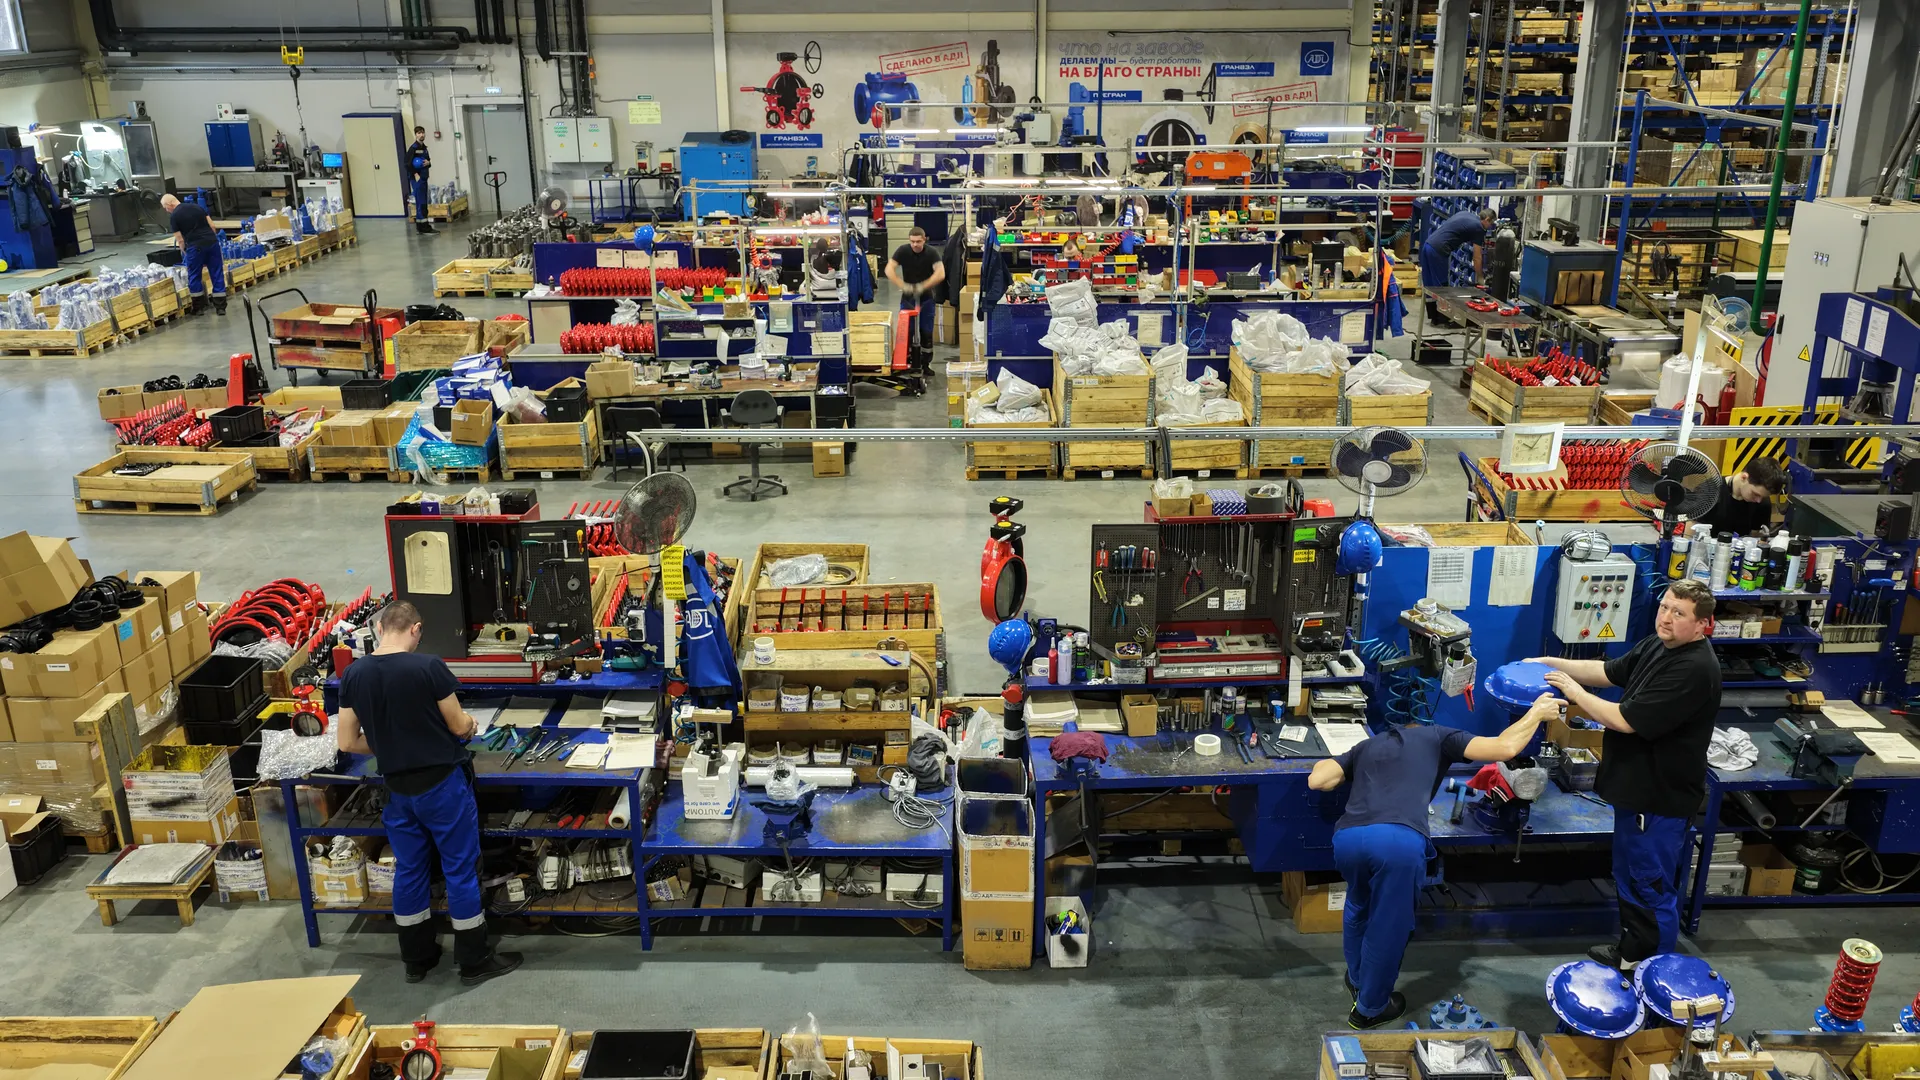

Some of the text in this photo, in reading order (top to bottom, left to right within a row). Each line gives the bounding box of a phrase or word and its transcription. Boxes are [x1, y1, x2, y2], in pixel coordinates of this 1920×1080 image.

[1107, 42, 1131, 56] на
[1135, 37, 1204, 56] заводе
[886, 56, 933, 71] СДЕЛАНО
[943, 52, 964, 62] АДЛ
[1060, 56, 1202, 66] ДЕЛАЕМ МЫ будет работать
[1059, 66, 1201, 78] НА БЛАГО СТРАНЫ!
